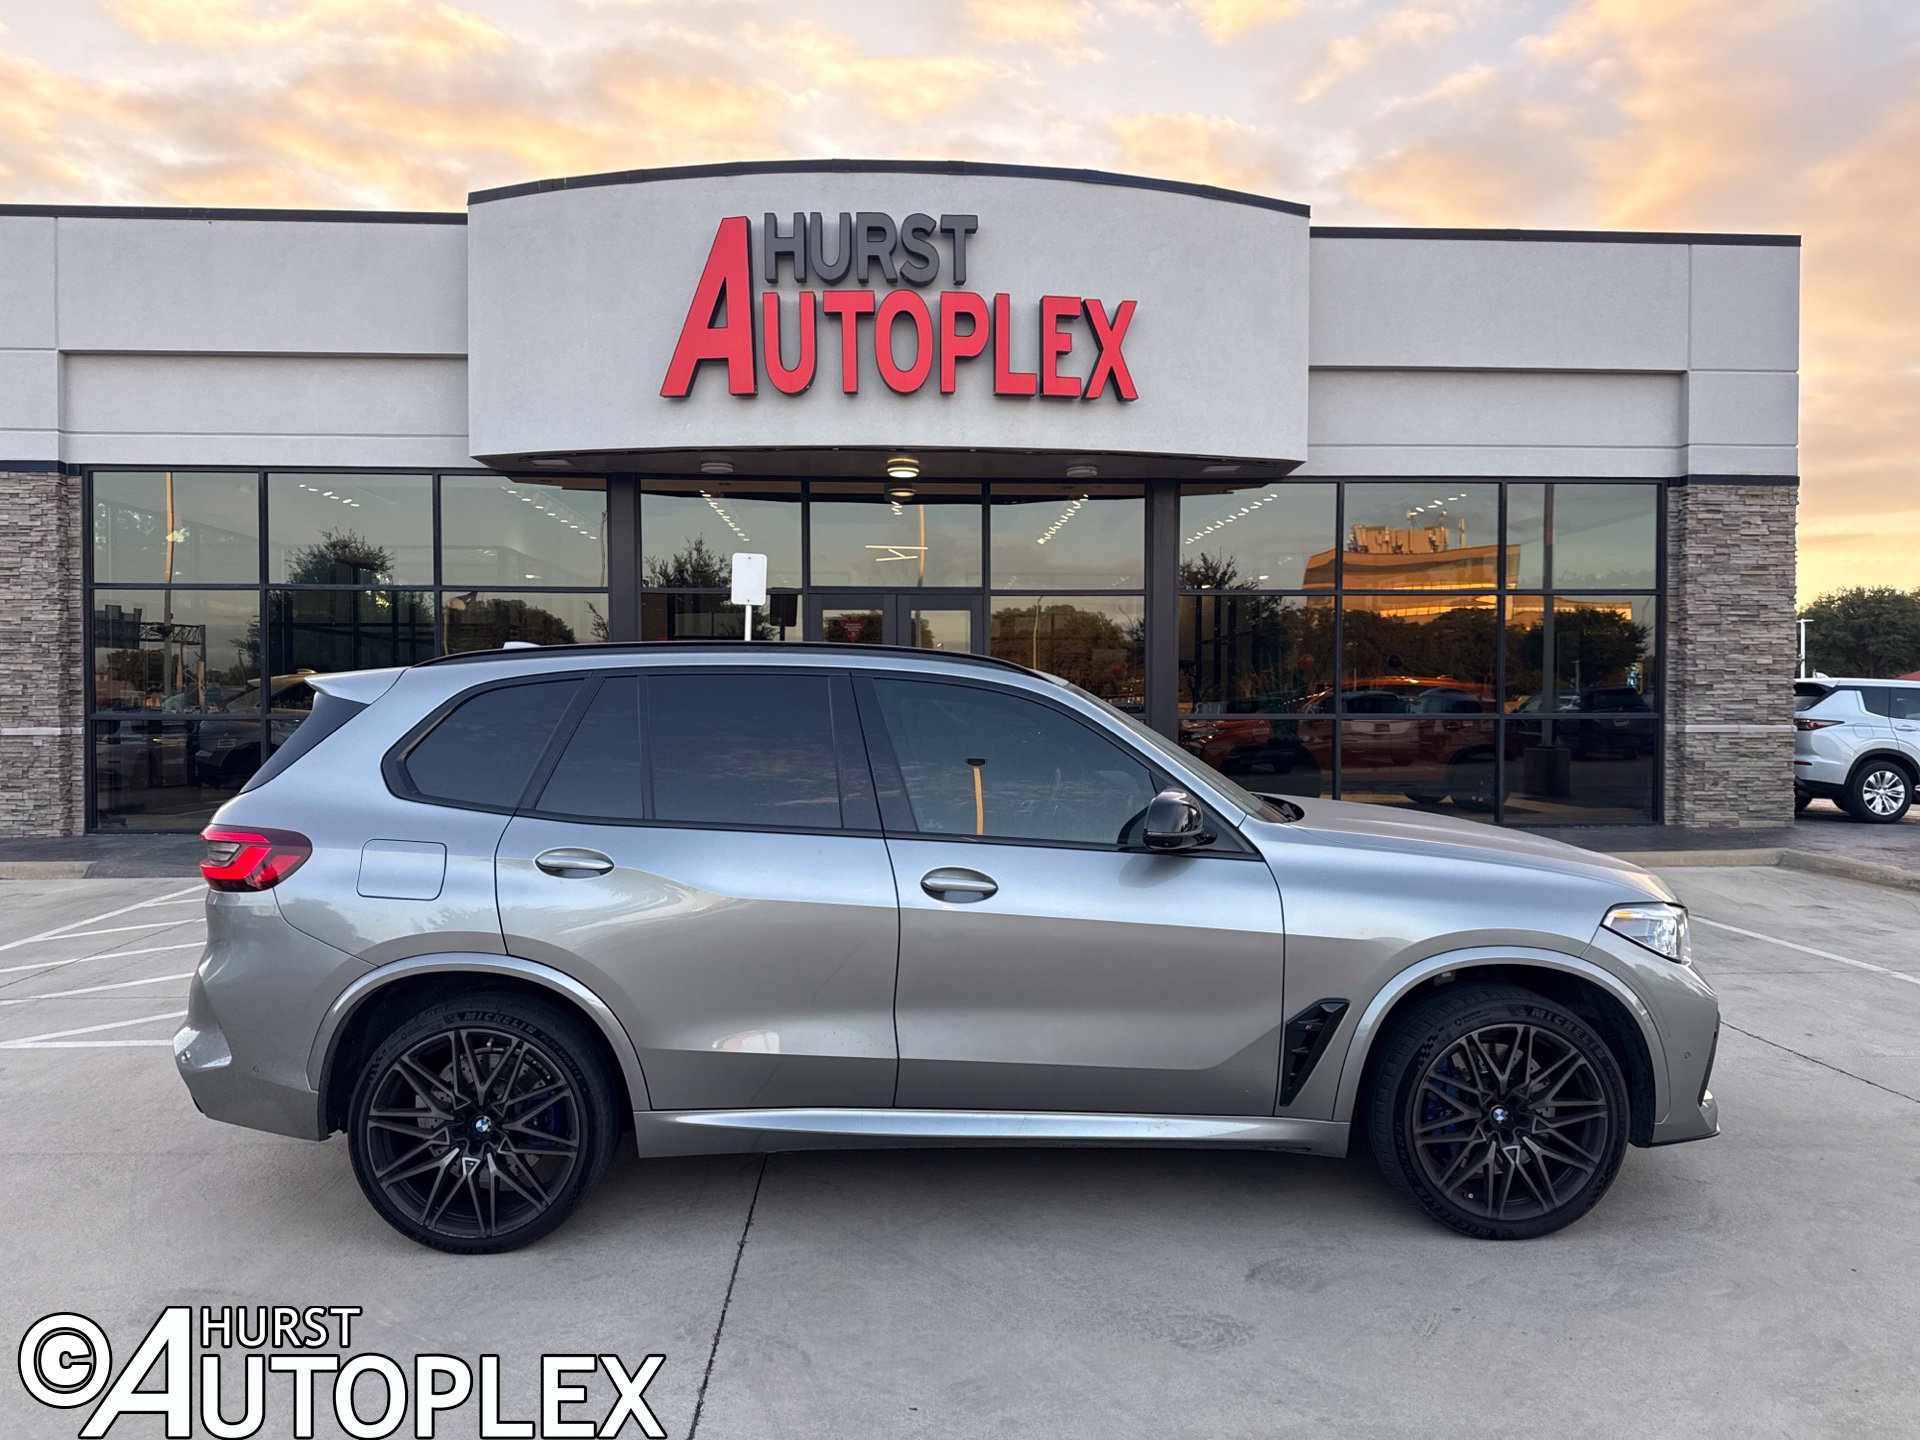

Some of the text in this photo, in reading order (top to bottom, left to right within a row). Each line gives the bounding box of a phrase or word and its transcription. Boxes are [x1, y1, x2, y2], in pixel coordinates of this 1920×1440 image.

[763, 211, 979, 286] HURST
[659, 215, 1139, 402] AUTOPLEX
[464, 1011, 537, 1034] MICHELIN
[1531, 1008, 1606, 1060] MICHELIN
